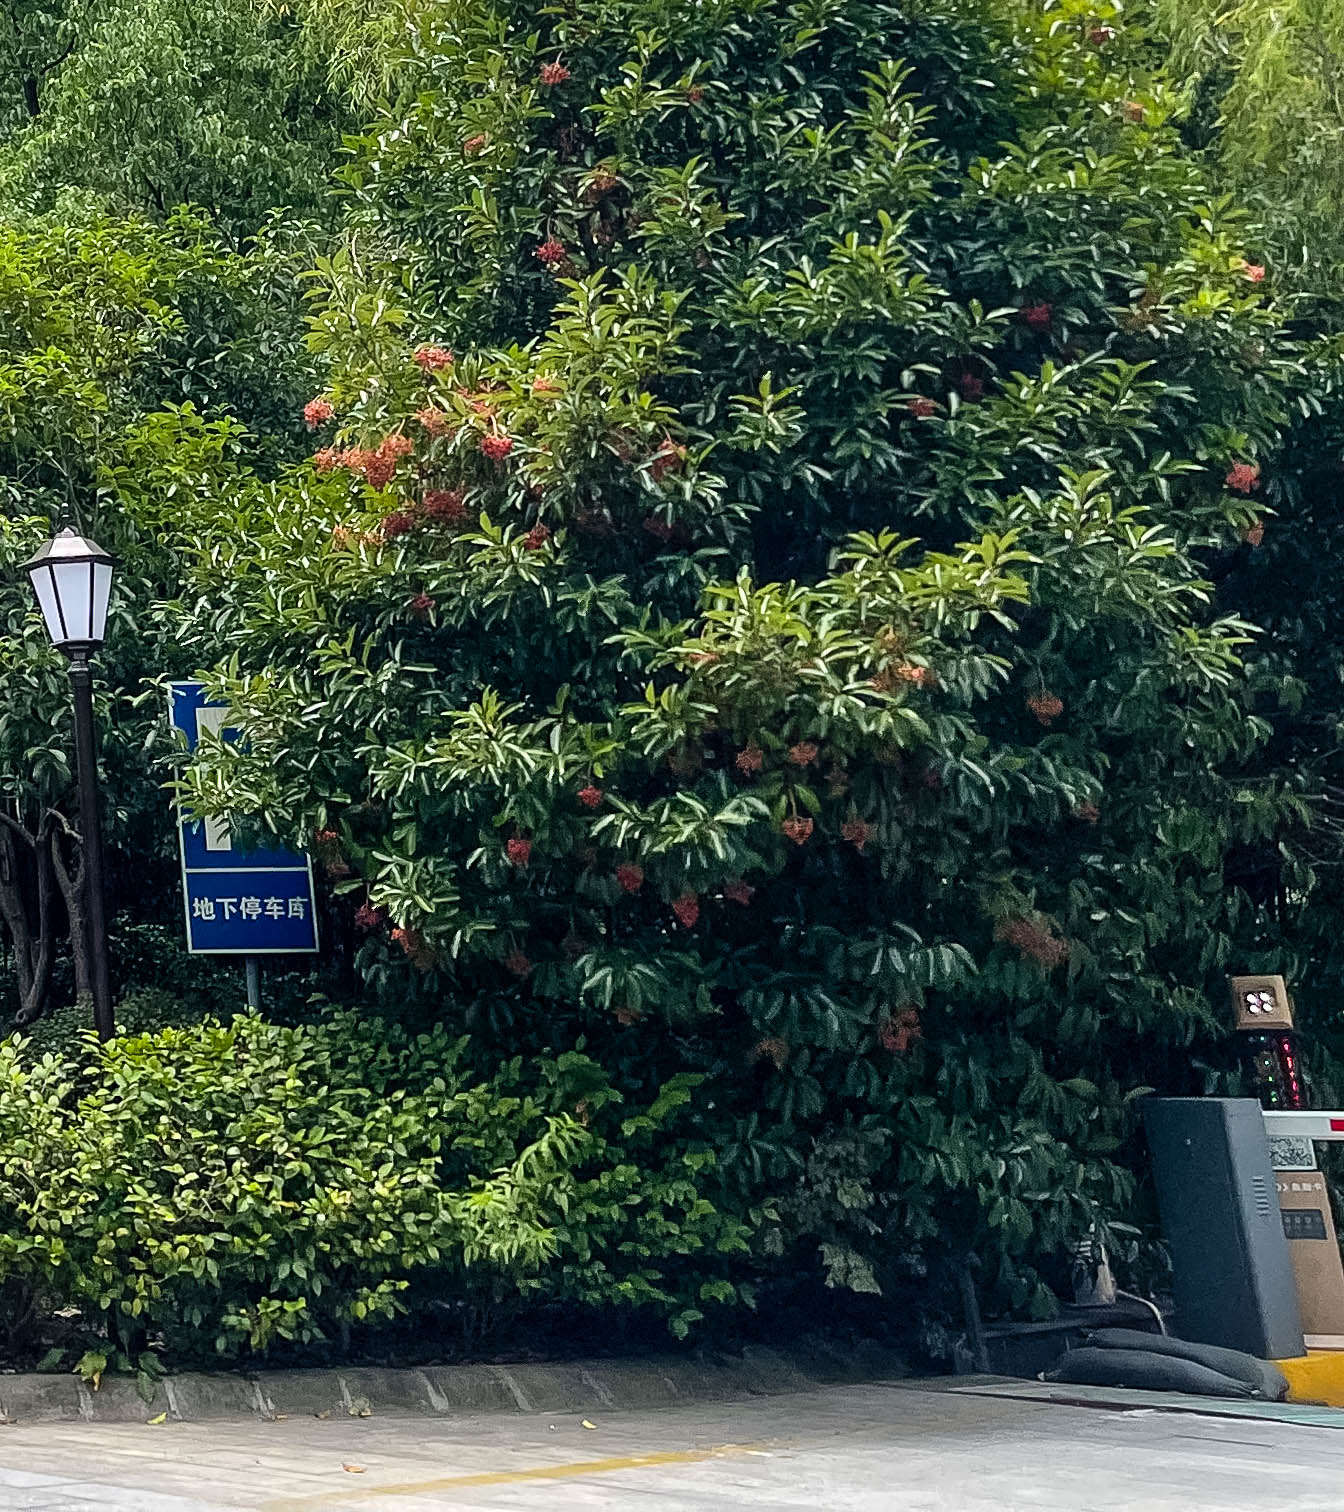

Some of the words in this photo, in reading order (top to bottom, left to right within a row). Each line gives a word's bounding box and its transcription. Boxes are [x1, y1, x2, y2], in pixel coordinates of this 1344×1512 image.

[192, 896, 308, 920] 地下停车库
